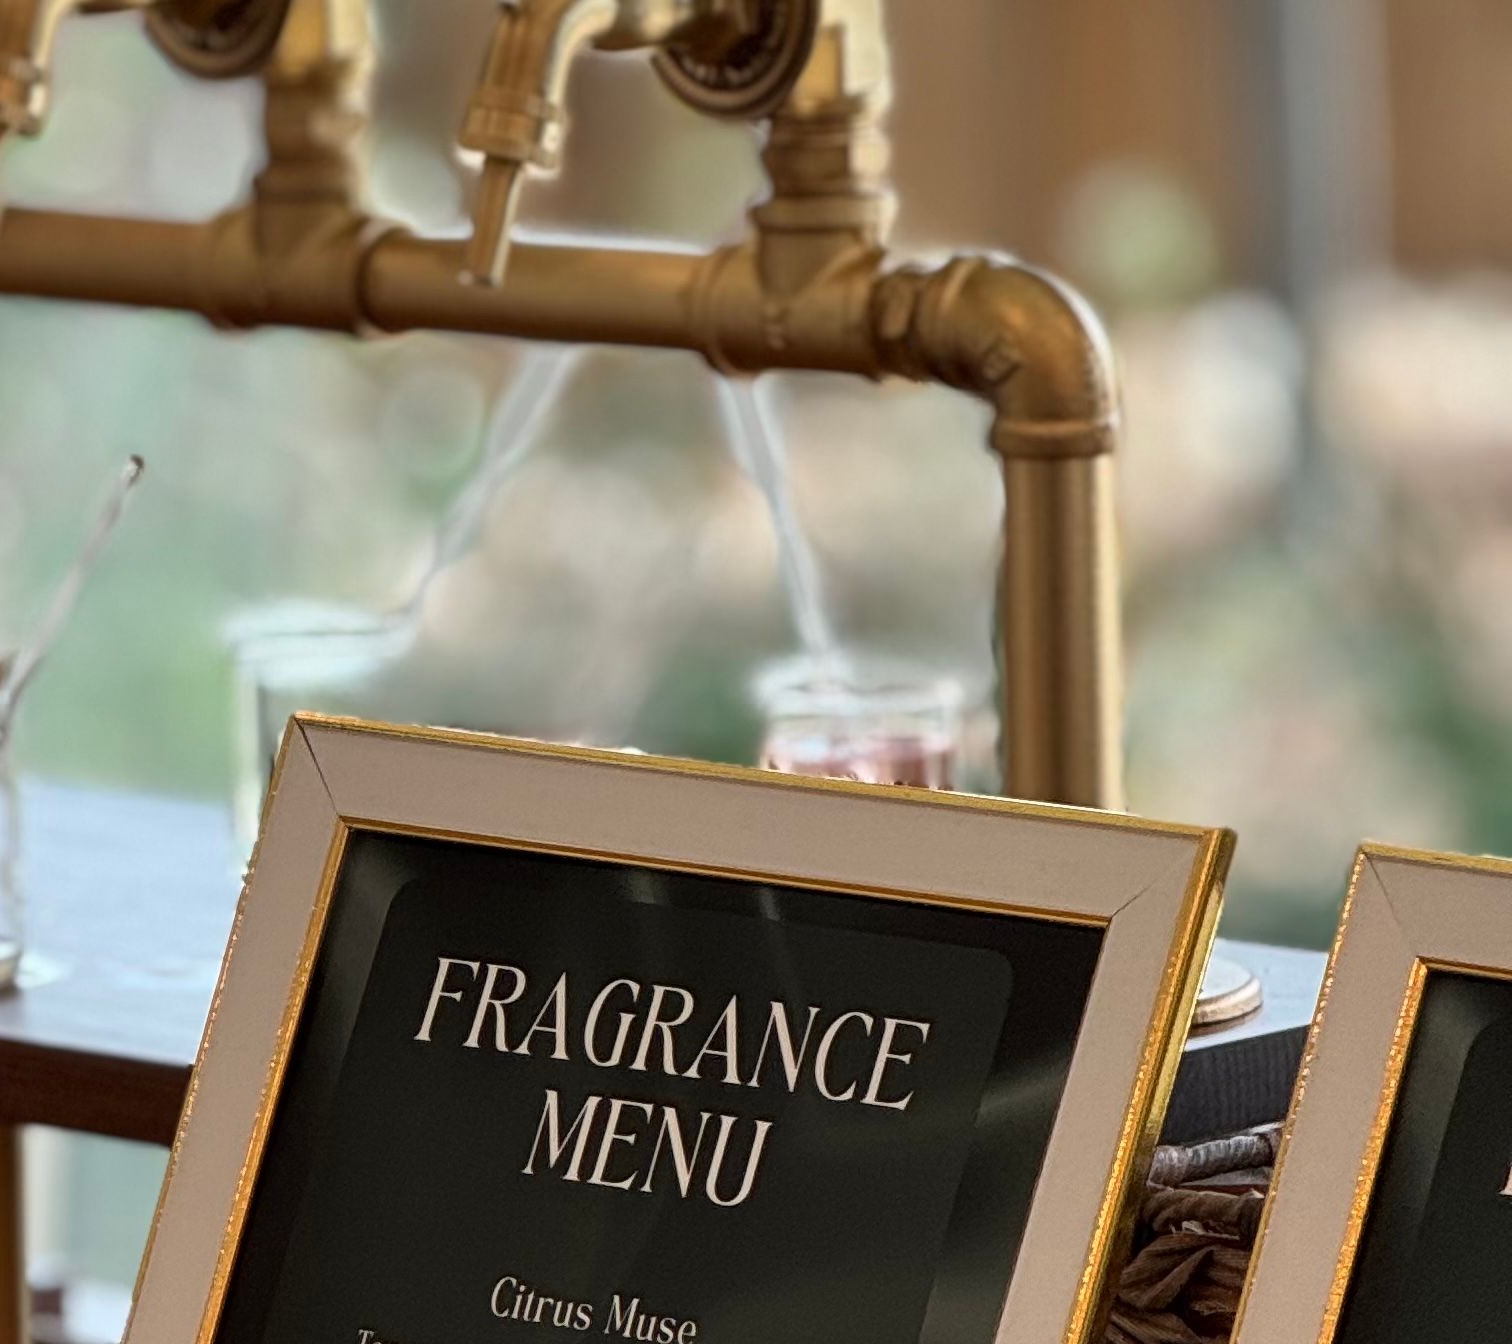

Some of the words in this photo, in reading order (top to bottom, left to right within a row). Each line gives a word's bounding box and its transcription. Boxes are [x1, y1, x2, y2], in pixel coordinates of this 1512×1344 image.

[413, 956, 931, 1111] FRAGRANCE
[521, 1089, 773, 1207] MENU
[490, 1276, 593, 1331] Citrus
